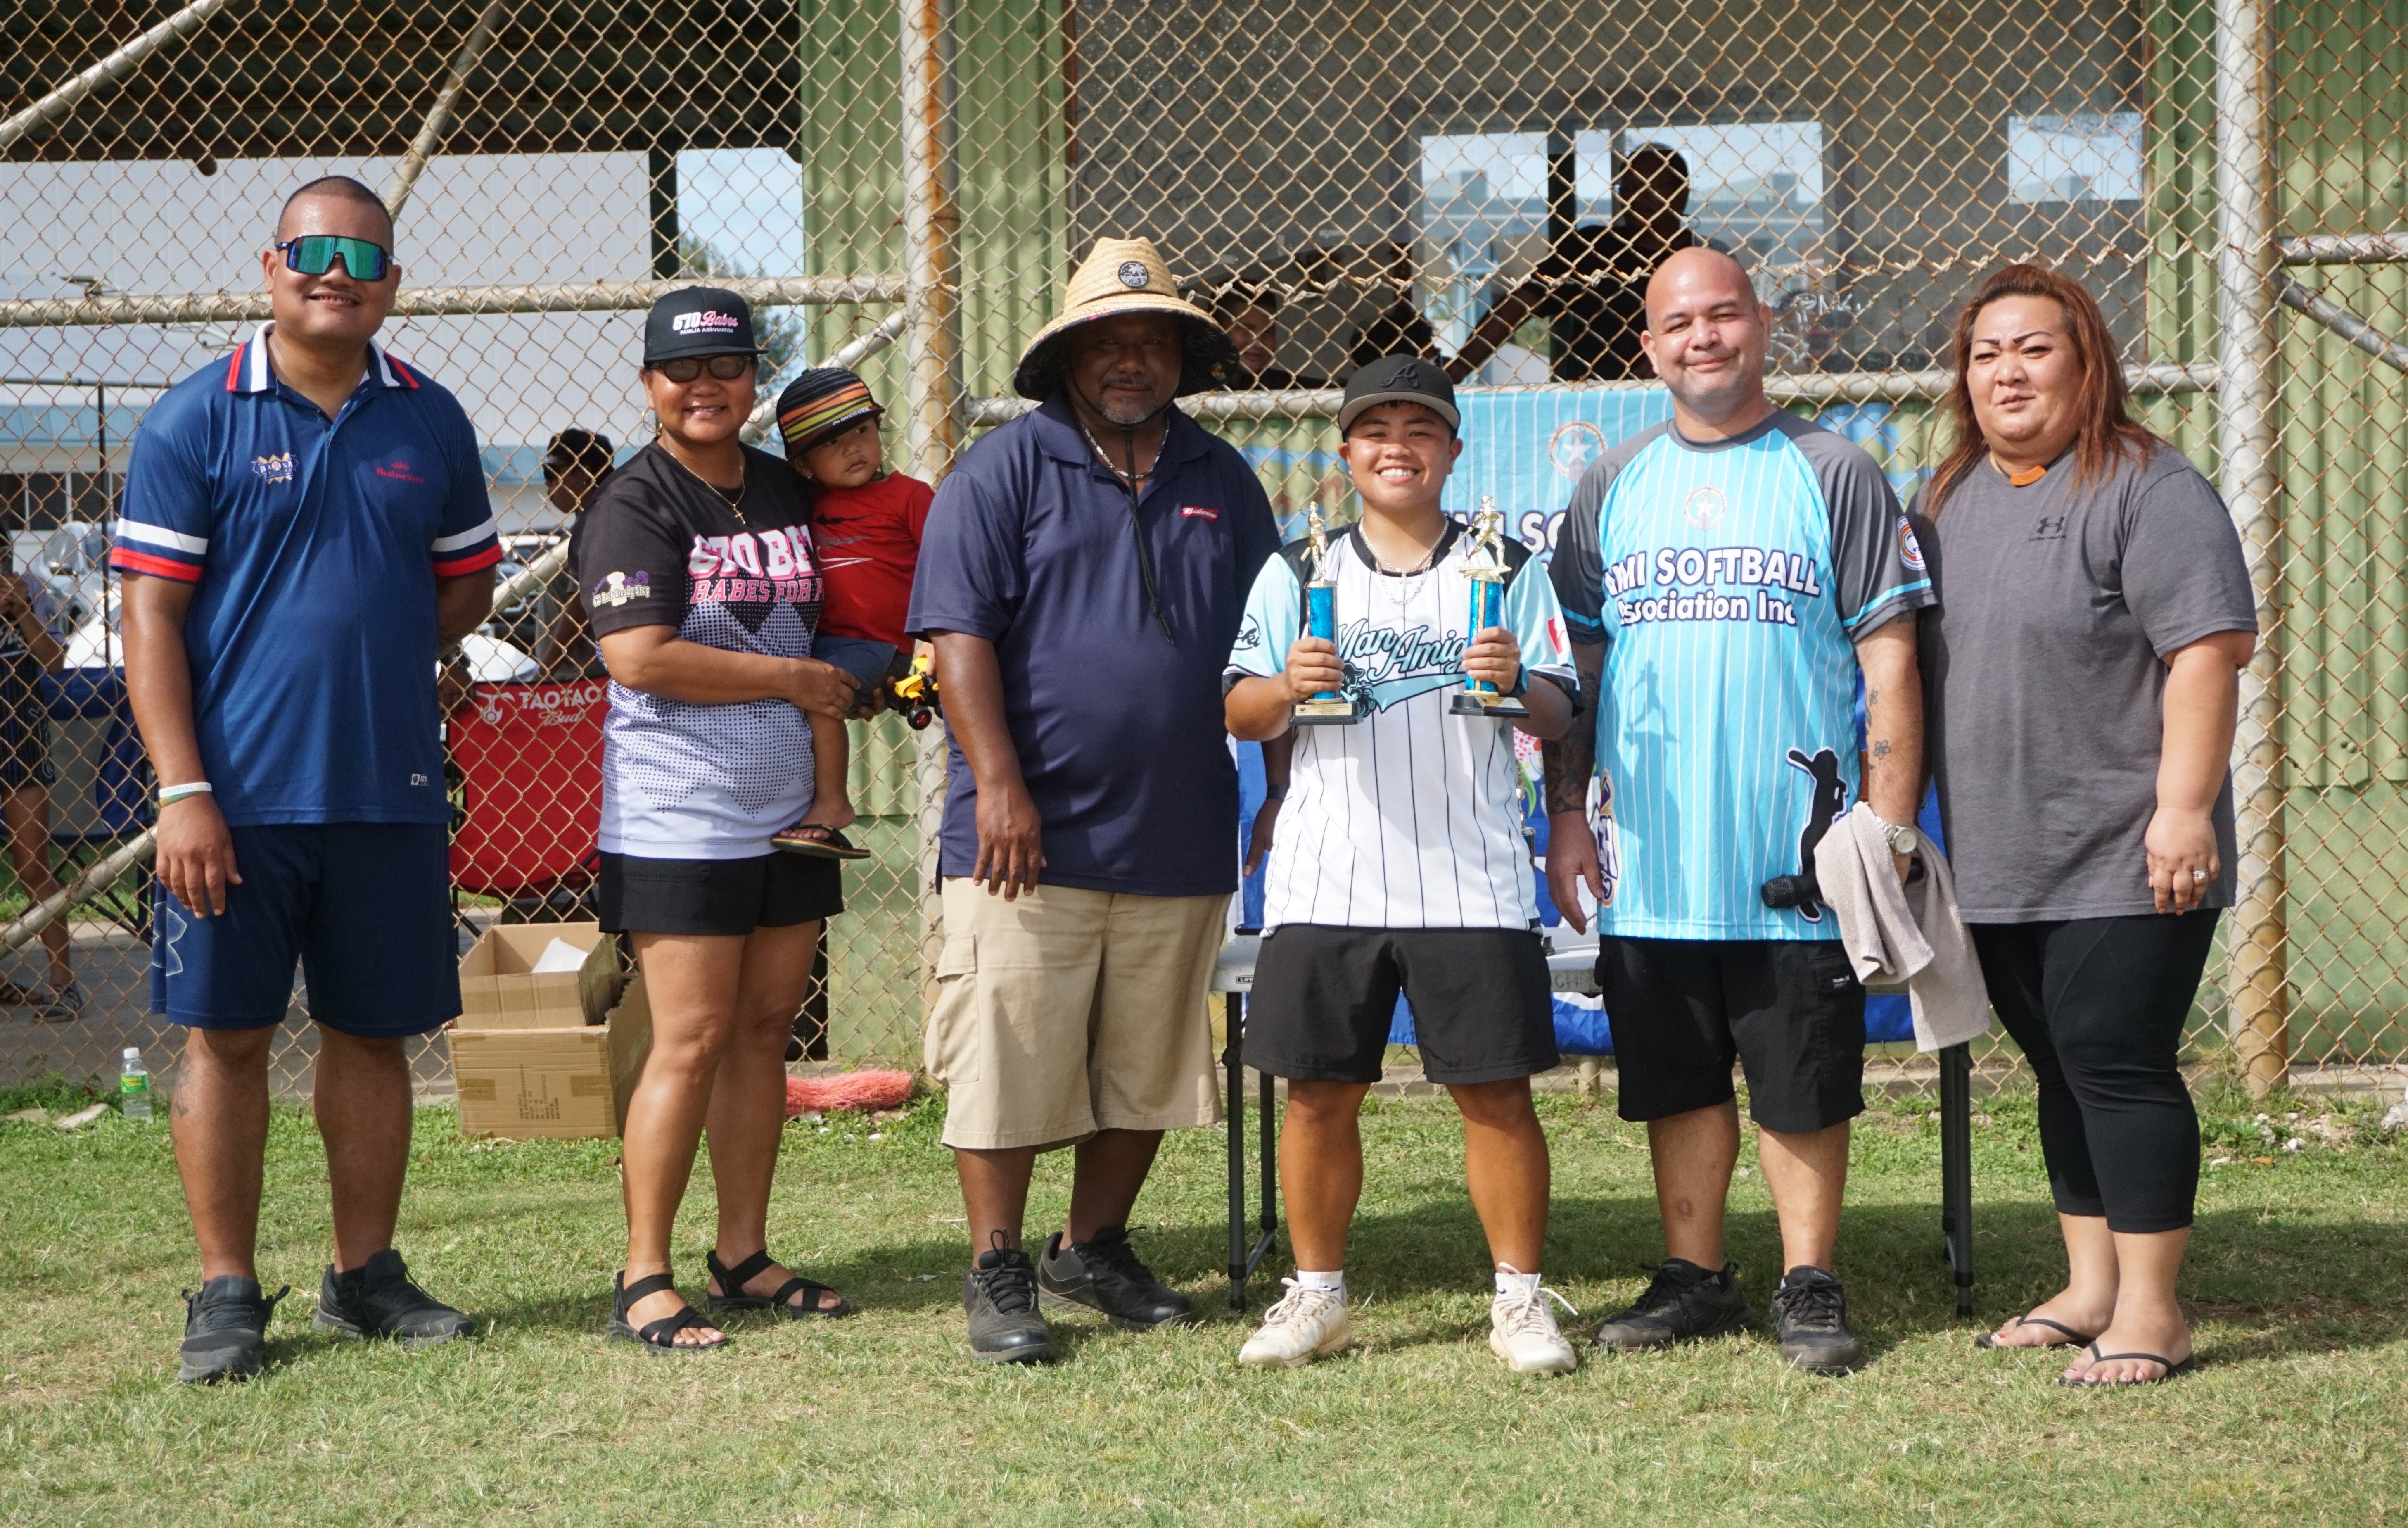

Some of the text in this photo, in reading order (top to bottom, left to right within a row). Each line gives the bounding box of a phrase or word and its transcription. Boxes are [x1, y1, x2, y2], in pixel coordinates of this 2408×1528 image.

[673, 311, 738, 330] 670 Babes
[376, 467, 425, 484] Budweiser
[1182, 507, 1218, 519] Budweiser
[688, 531, 764, 579] 670
[1654, 546, 1820, 598] SOFTBALL
[601, 591, 614, 604] Rock
[614, 586, 635, 599] Steady
[635, 585, 650, 598] Shop
[690, 579, 770, 604] BABES
[773, 578, 811, 603] FOR
[519, 686, 602, 709] TAOTAO
[538, 709, 586, 727] Bud
